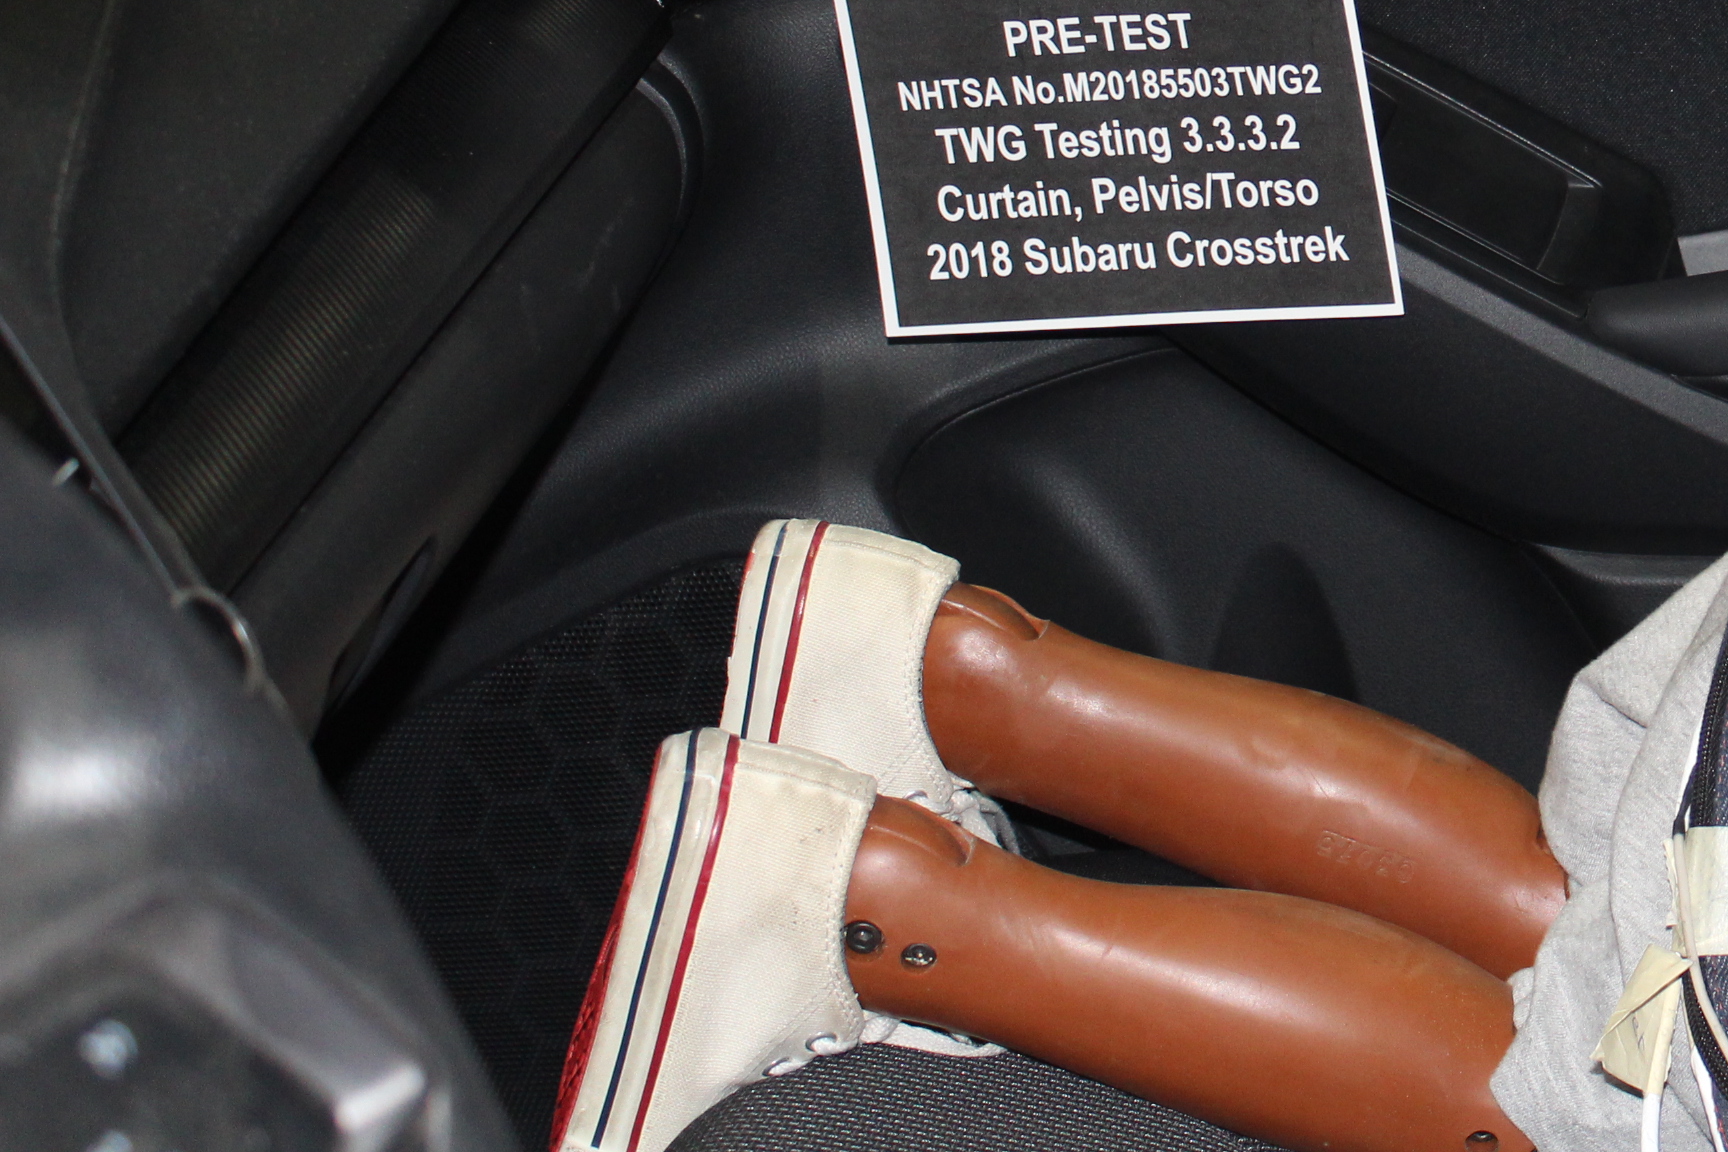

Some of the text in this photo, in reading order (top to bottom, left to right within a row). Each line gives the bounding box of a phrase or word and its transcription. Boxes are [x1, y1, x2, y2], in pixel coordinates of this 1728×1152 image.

[1002, 12, 1192, 58] PRE-TEST
[897, 63, 1322, 112] NHTSA No.M20185503TWG2
[934, 113, 1301, 165] TWG Testing 3.3.3.2
[937, 172, 1319, 223] Curtain, Pelvis/Torso
[926, 225, 1351, 281] 2018 Subaru Crosstrek
